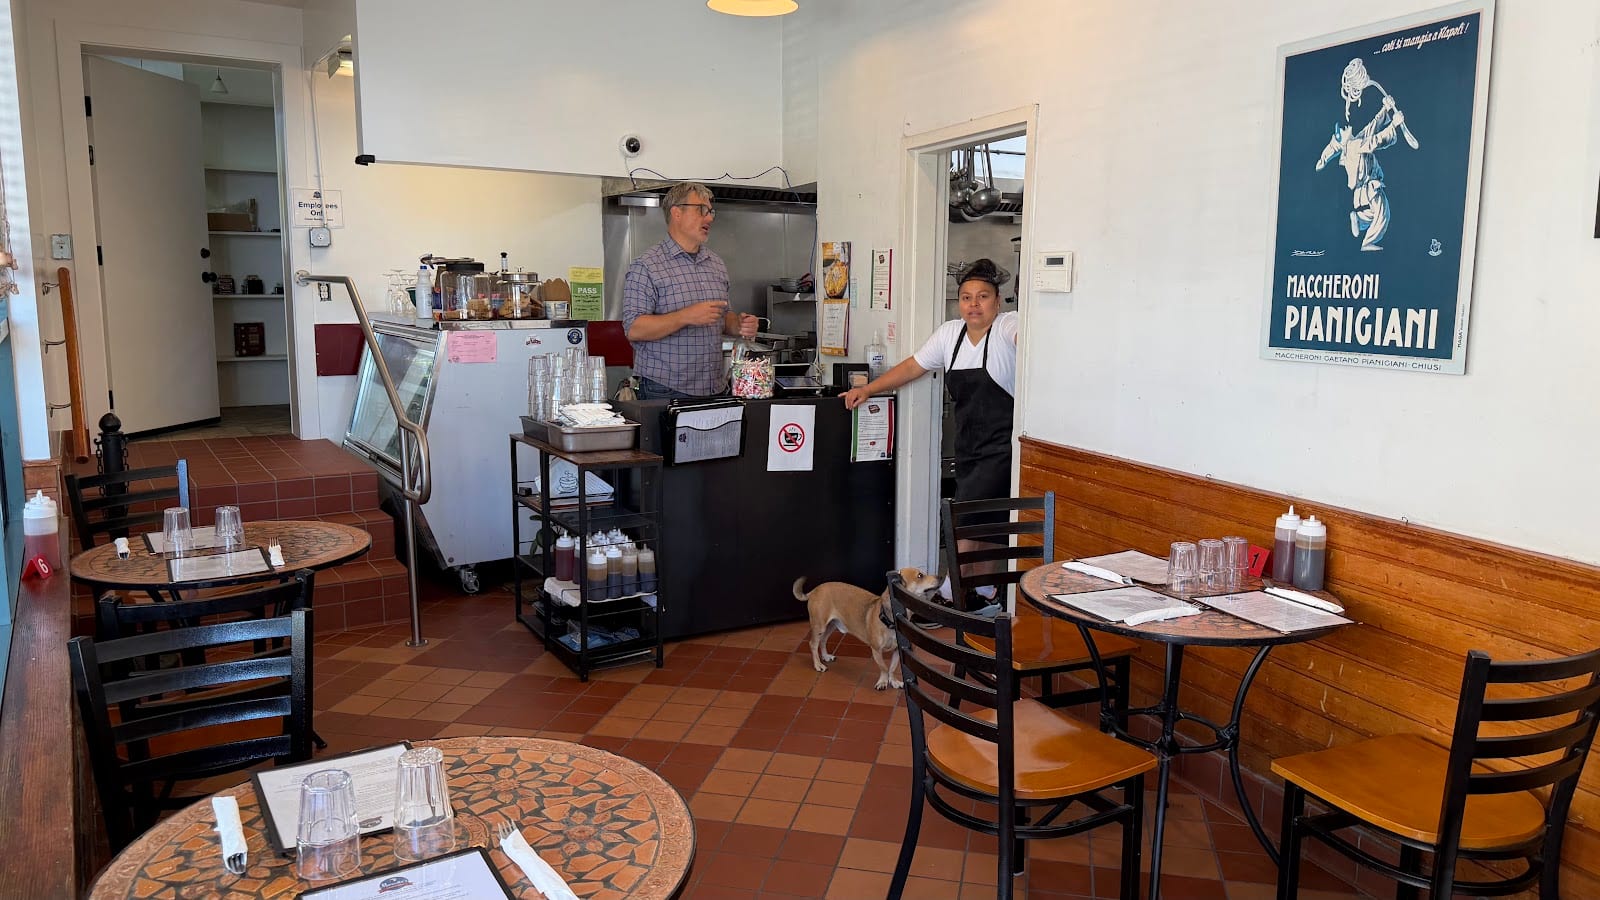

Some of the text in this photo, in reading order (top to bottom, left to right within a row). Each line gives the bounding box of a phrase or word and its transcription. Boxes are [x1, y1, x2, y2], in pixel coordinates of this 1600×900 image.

[1403, 31, 1432, 50] mangia
[298, 201, 338, 209] Emploees
[1286, 274, 1379, 299] MACCHERONI
[1284, 305, 1438, 349] PIANIGIANI
[1274, 352, 1322, 361] MACCHERONI
[1324, 355, 1359, 364] GAETANO
[37, 558, 49, 574] 6
[1251, 552, 1260, 568] 1
